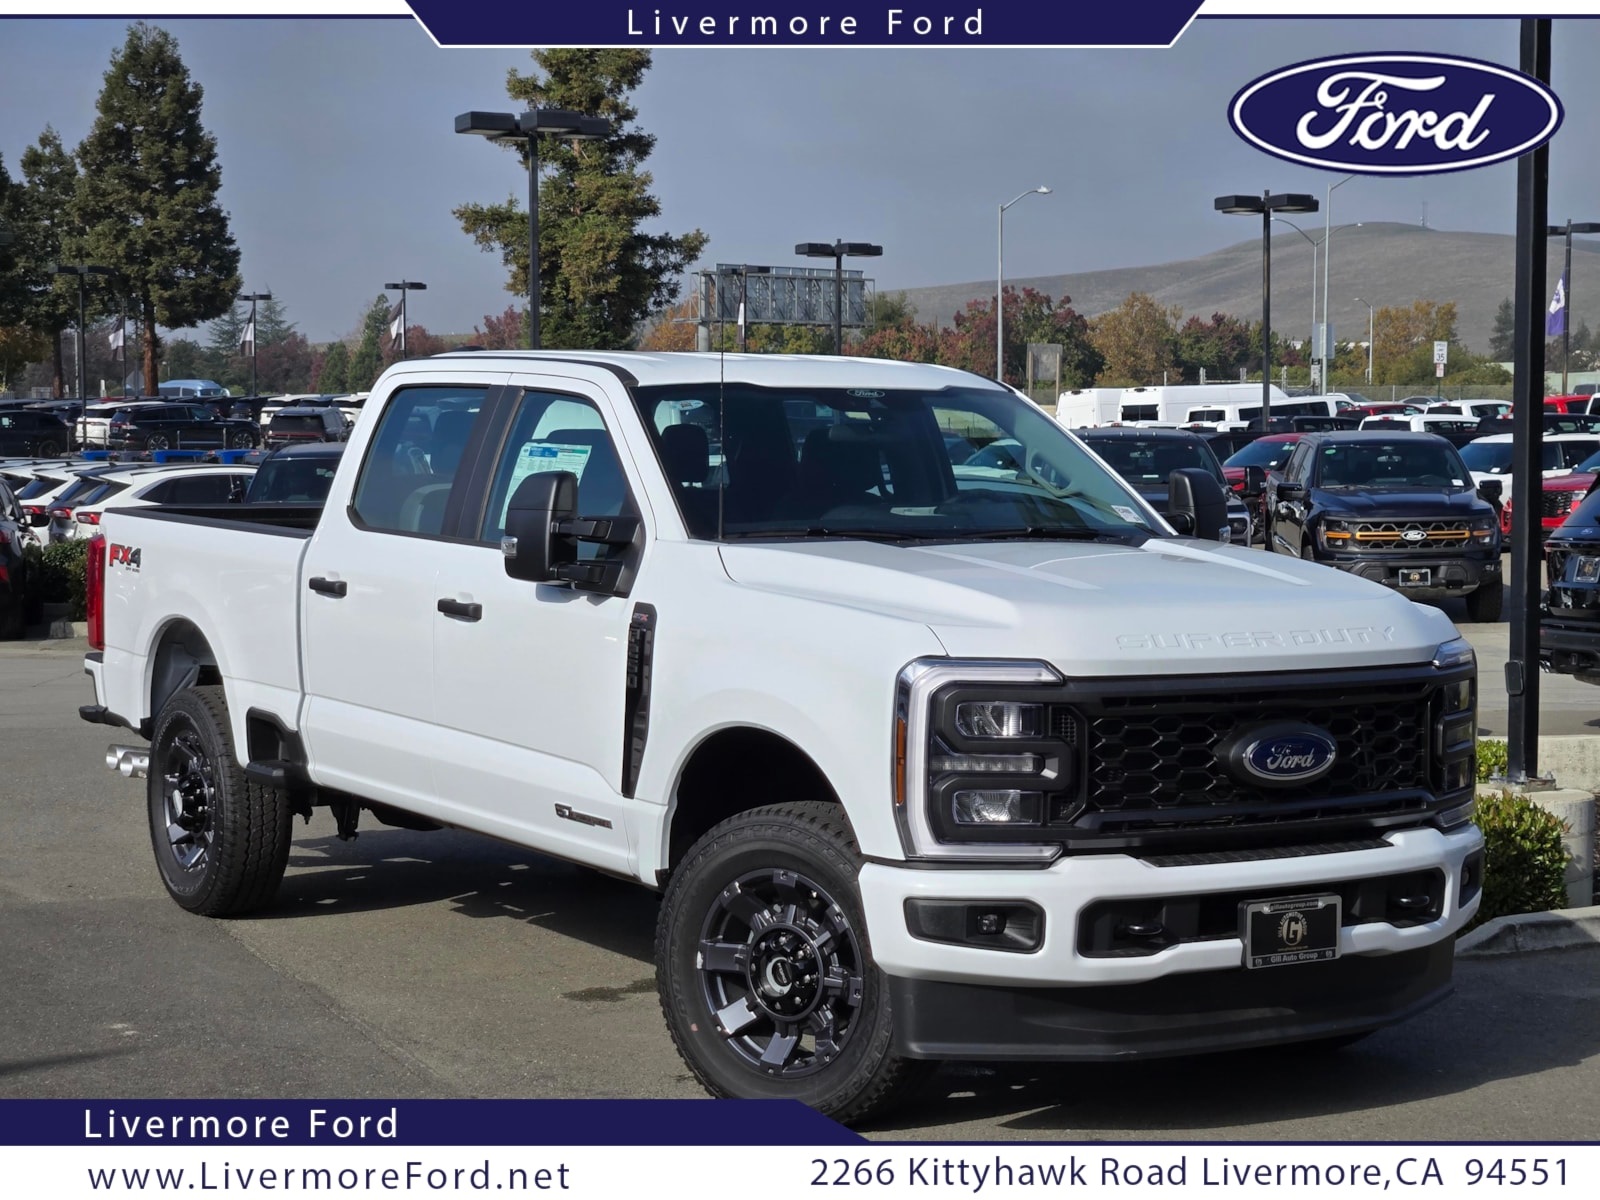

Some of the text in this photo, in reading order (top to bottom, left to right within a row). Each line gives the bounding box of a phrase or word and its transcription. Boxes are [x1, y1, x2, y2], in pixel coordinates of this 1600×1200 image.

[109, 543, 141, 568] FX4
[1115, 625, 1395, 650] SUPER DUTY
[1266, 743, 1315, 769] Ford
[1270, 951, 1318, 963] Gill Auto Group
